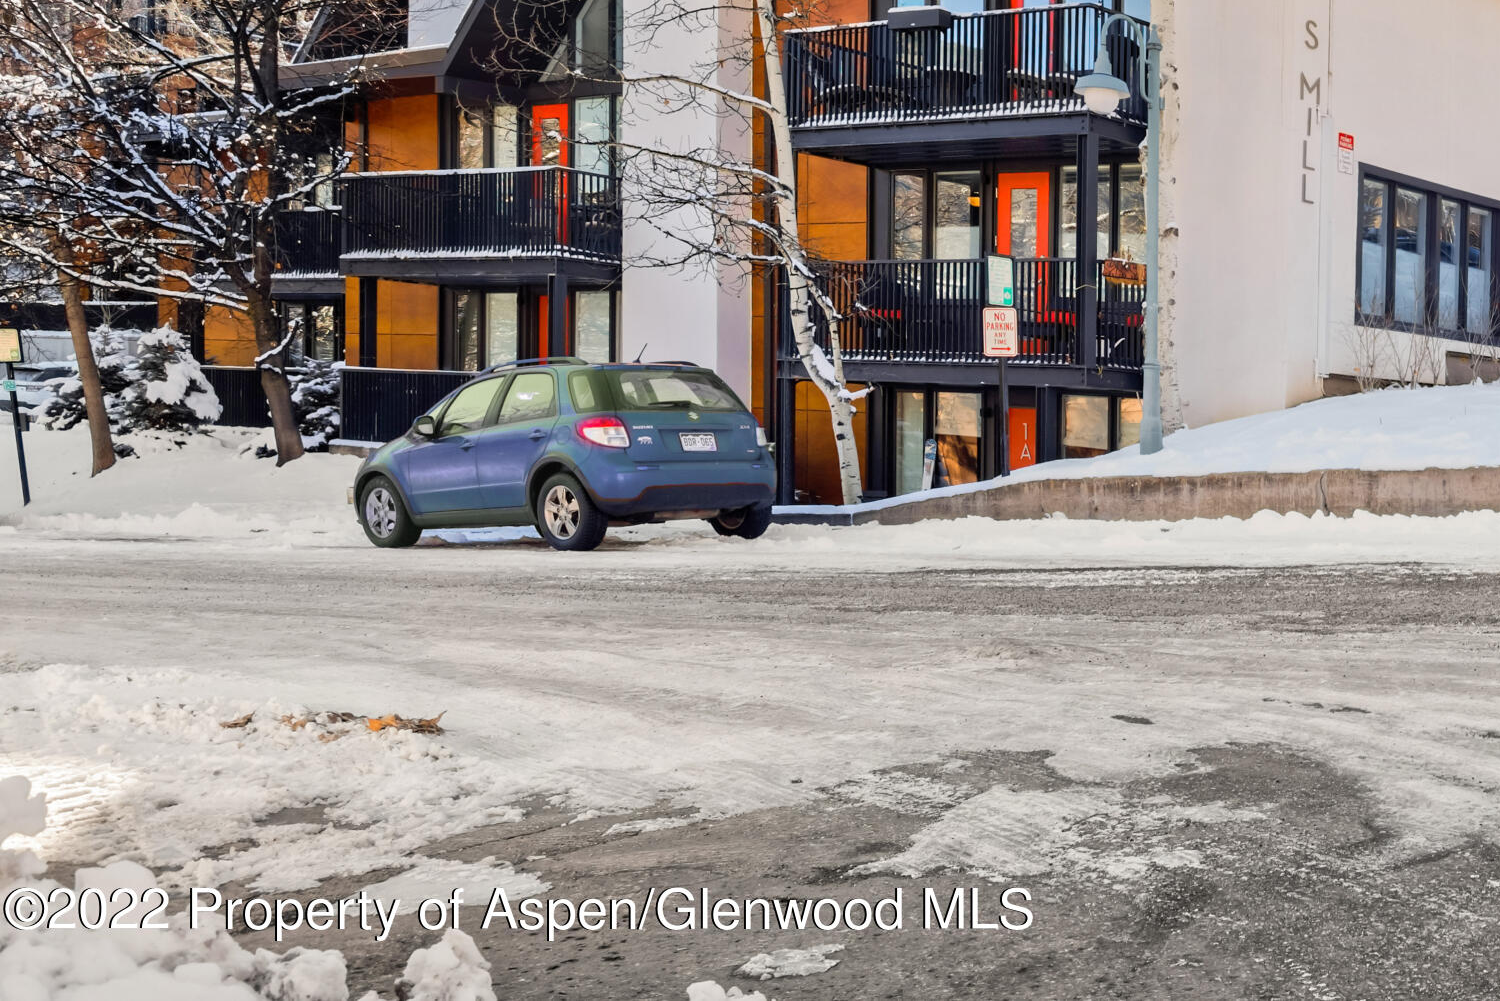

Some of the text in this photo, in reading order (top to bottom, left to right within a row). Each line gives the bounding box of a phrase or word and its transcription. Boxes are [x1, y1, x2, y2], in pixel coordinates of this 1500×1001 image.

[1305, 20, 1319, 50] S
[1300, 71, 1321, 204] MILL
[993, 312, 1006, 321] NO
[986, 322, 1014, 331] PARKING
